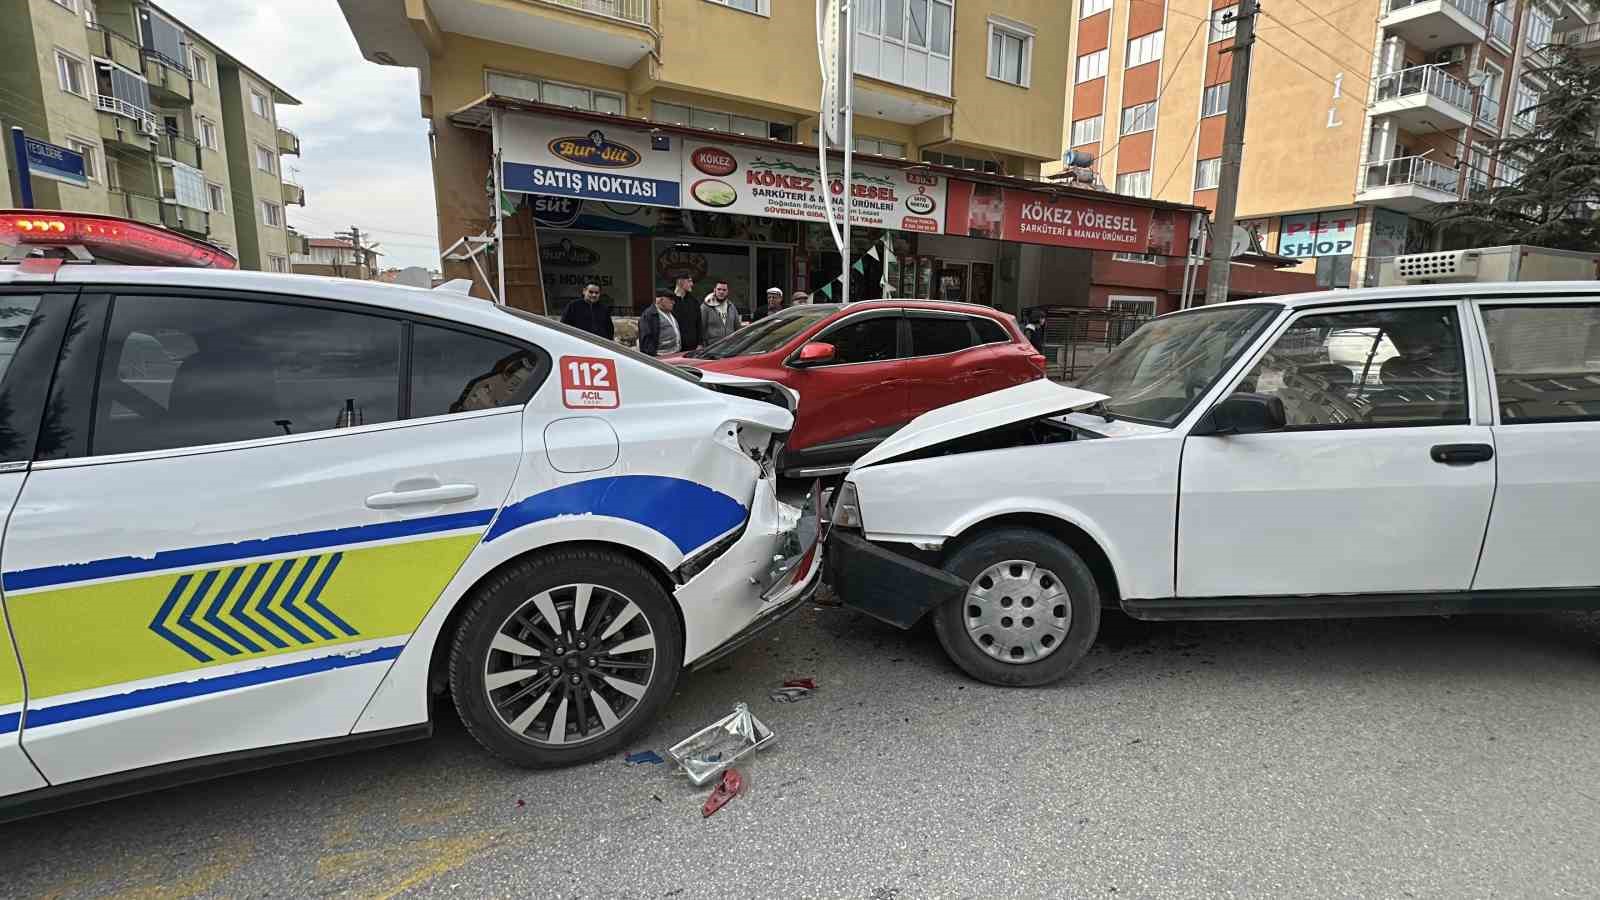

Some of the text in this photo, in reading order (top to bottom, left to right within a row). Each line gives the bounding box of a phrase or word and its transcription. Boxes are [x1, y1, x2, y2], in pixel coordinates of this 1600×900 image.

[533, 168, 657, 197] SATIŞ NOKTASI
[746, 169, 814, 191] KÖKEZ
[819, 178, 898, 202] ÖESEL
[752, 188, 894, 211] ŞARKÜTERİ & MNA ÜRÜNLERİ
[1021, 201, 1137, 232] KÖKEZ YÖRESEL
[1287, 218, 1352, 237] PET
[1020, 223, 1065, 236] ŞARKÜTERİ
[1074, 229, 1101, 240] MANAV
[1102, 231, 1137, 243] ÜRÜNLERİ
[1282, 240, 1352, 256] SHOP
[568, 361, 610, 387] 112
